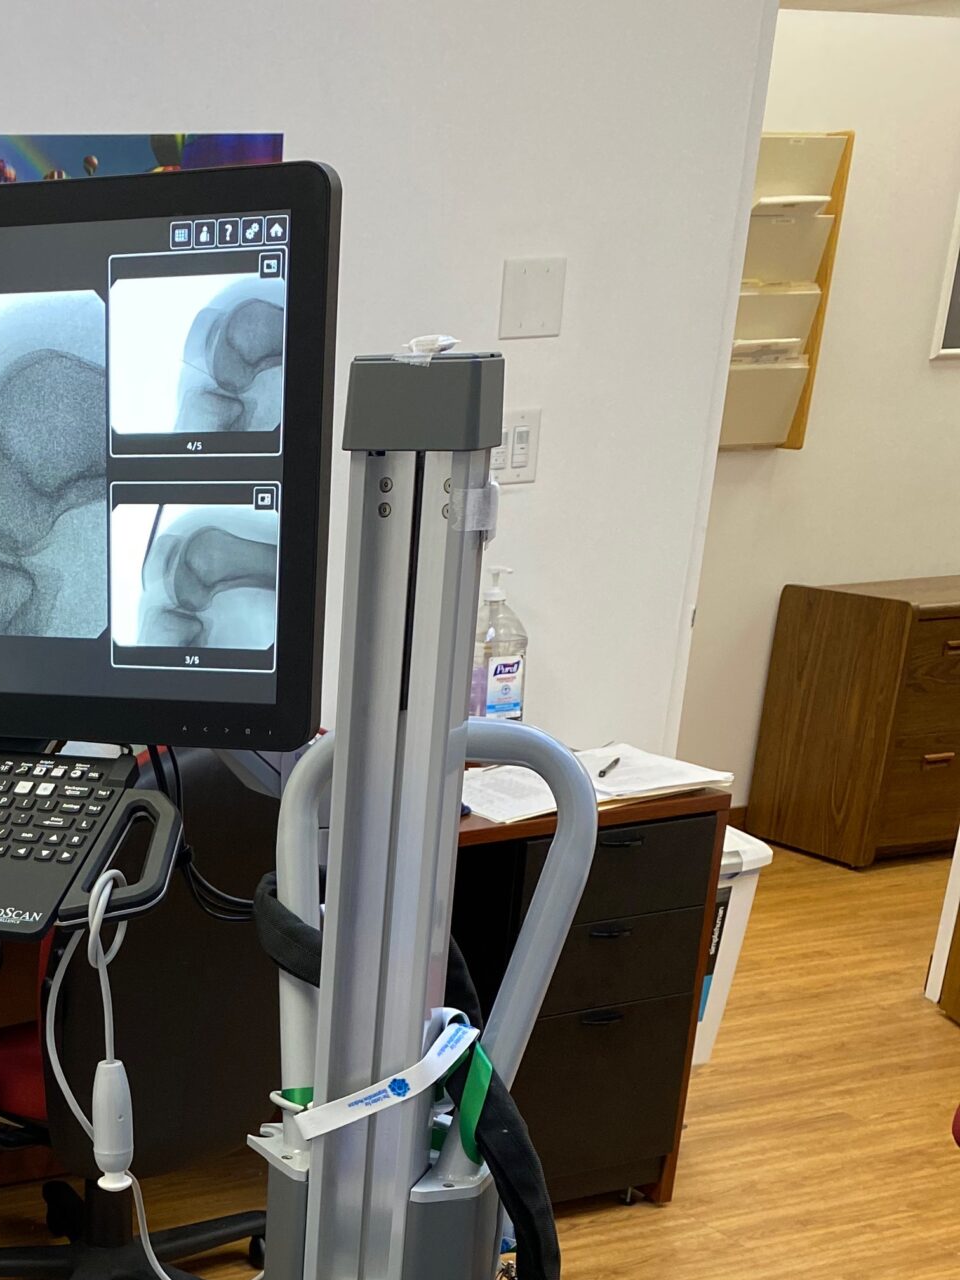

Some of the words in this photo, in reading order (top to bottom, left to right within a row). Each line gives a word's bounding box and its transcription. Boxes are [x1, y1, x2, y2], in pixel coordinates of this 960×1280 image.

[187, 441, 203, 451] 4/5
[184, 655, 200, 665] 3/5
[496, 663, 519, 674] Purell
[709, 906, 725, 956] simplehuman
